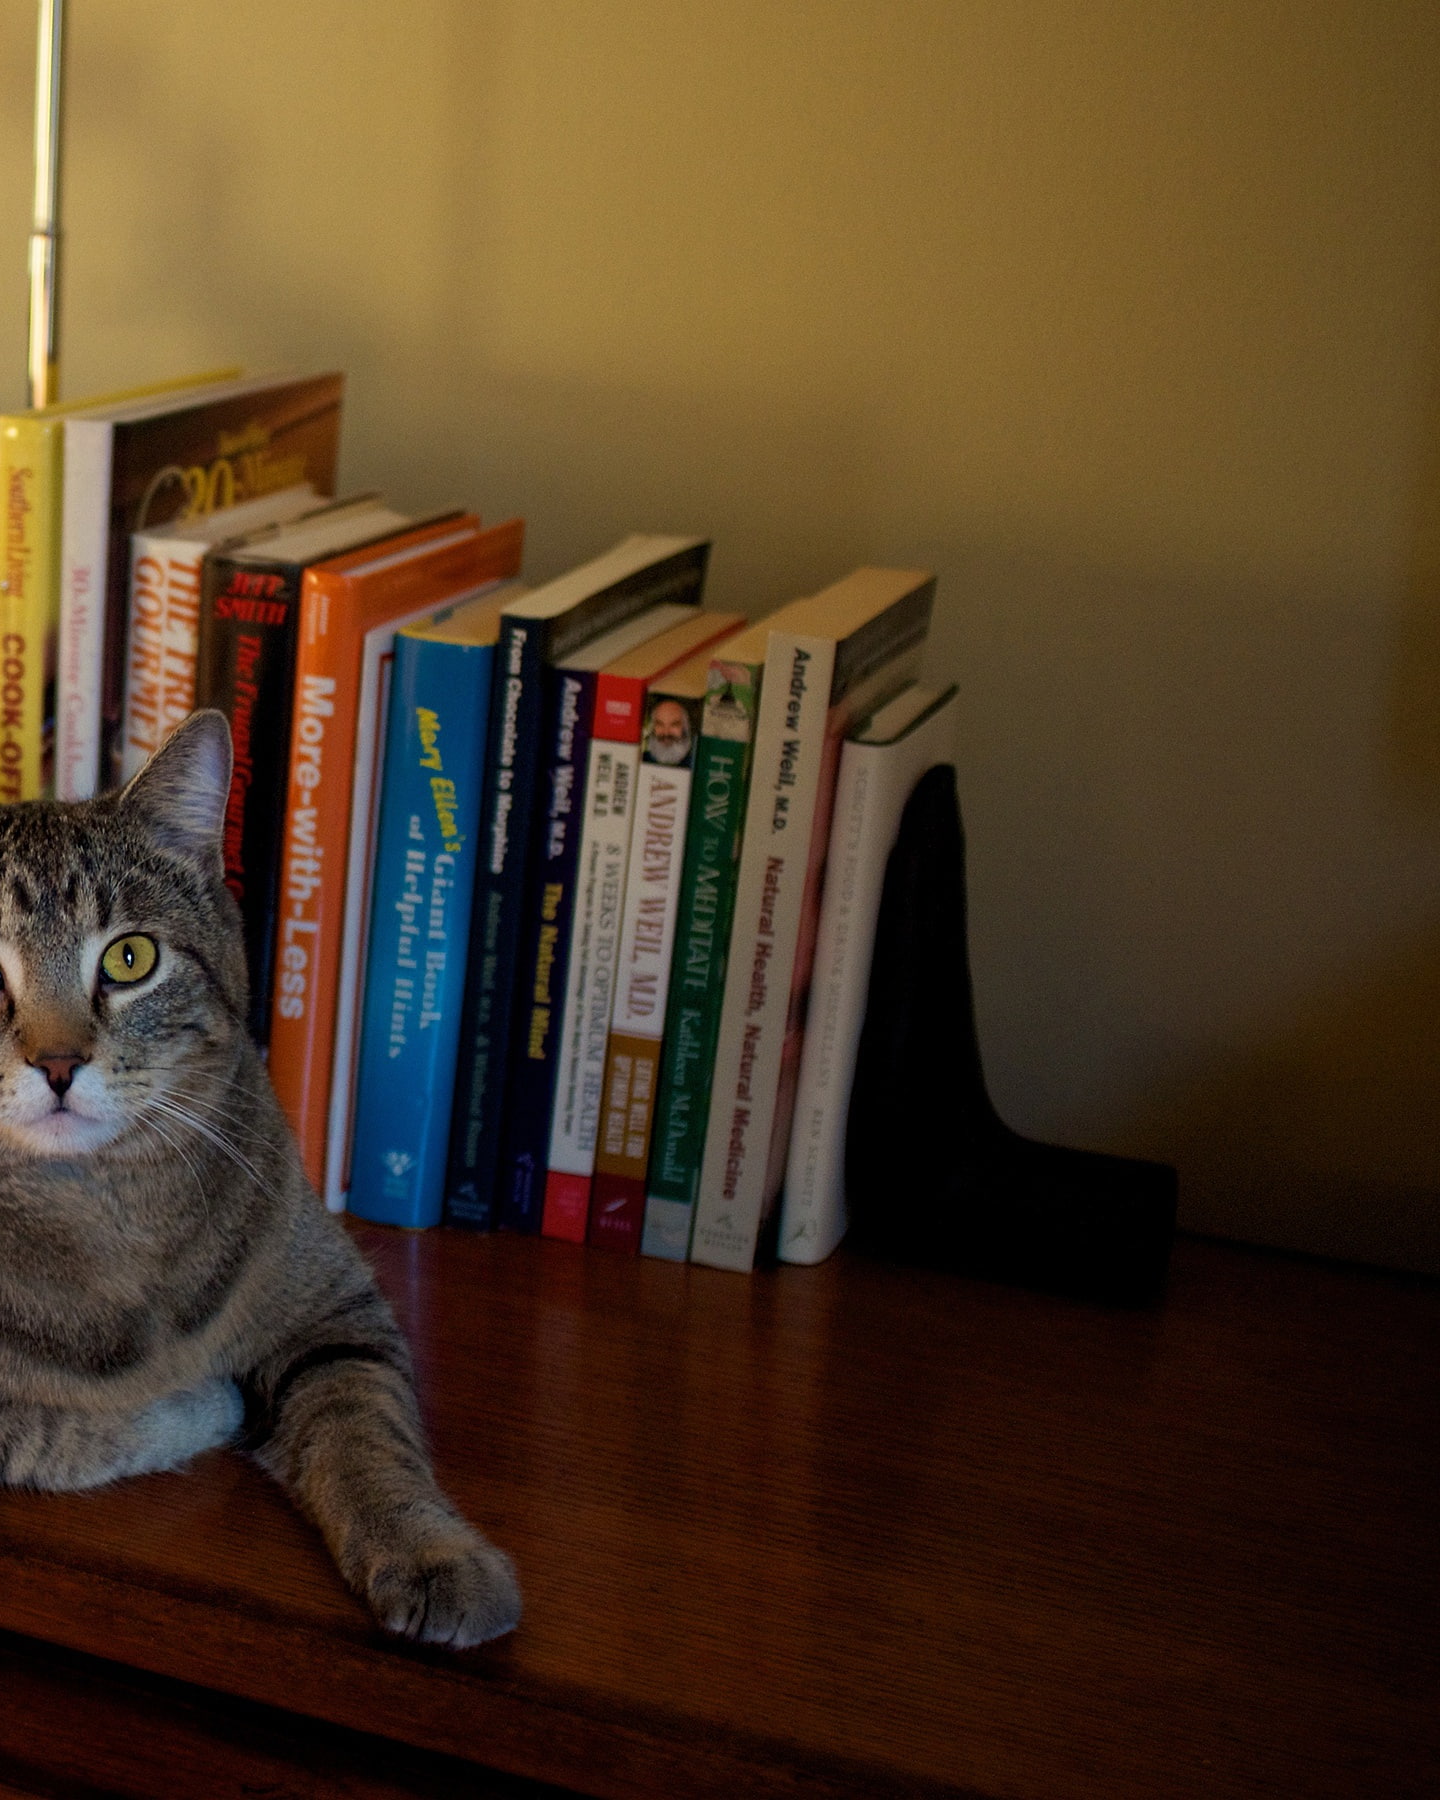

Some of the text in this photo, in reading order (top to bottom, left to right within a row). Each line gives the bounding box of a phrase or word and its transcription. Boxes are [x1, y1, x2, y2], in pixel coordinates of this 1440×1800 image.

[129, 556, 166, 756] GOURMET
[161, 557, 202, 742] THE TRU
[215, 597, 288, 625] SMITH
[785, 647, 813, 732] Andrew
[415, 707, 466, 852] Mary Ellen's
[490, 628, 528, 875] From Chocolate to Morphine
[549, 676, 583, 860] Andrew Weil, M.D.
[612, 761, 631, 816] ANDREW
[703, 754, 734, 833] HOW
[773, 740, 801, 792] Weil,
[278, 674, 336, 1020] More-with-Less
[771, 795, 791, 835] M.D.
[388, 814, 426, 1059] of Helpful Hints
[419, 854, 456, 1029] Giant Book
[626, 775, 678, 1020] ANDREW WEIL, M.D.
[683, 863, 721, 990] MEDITATE
[758, 854, 785, 937] Natural
[528, 882, 564, 1060] The Natural Mind
[577, 843, 621, 1152] 8 WEEKS TO OPTIMUM HEALTH
[744, 942, 773, 1017] Health,
[673, 1007, 702, 1086] Kathleen
[735, 1023, 762, 1102] Natural
[663, 1091, 692, 1184] McDonald
[722, 1107, 751, 1200] Medicine
